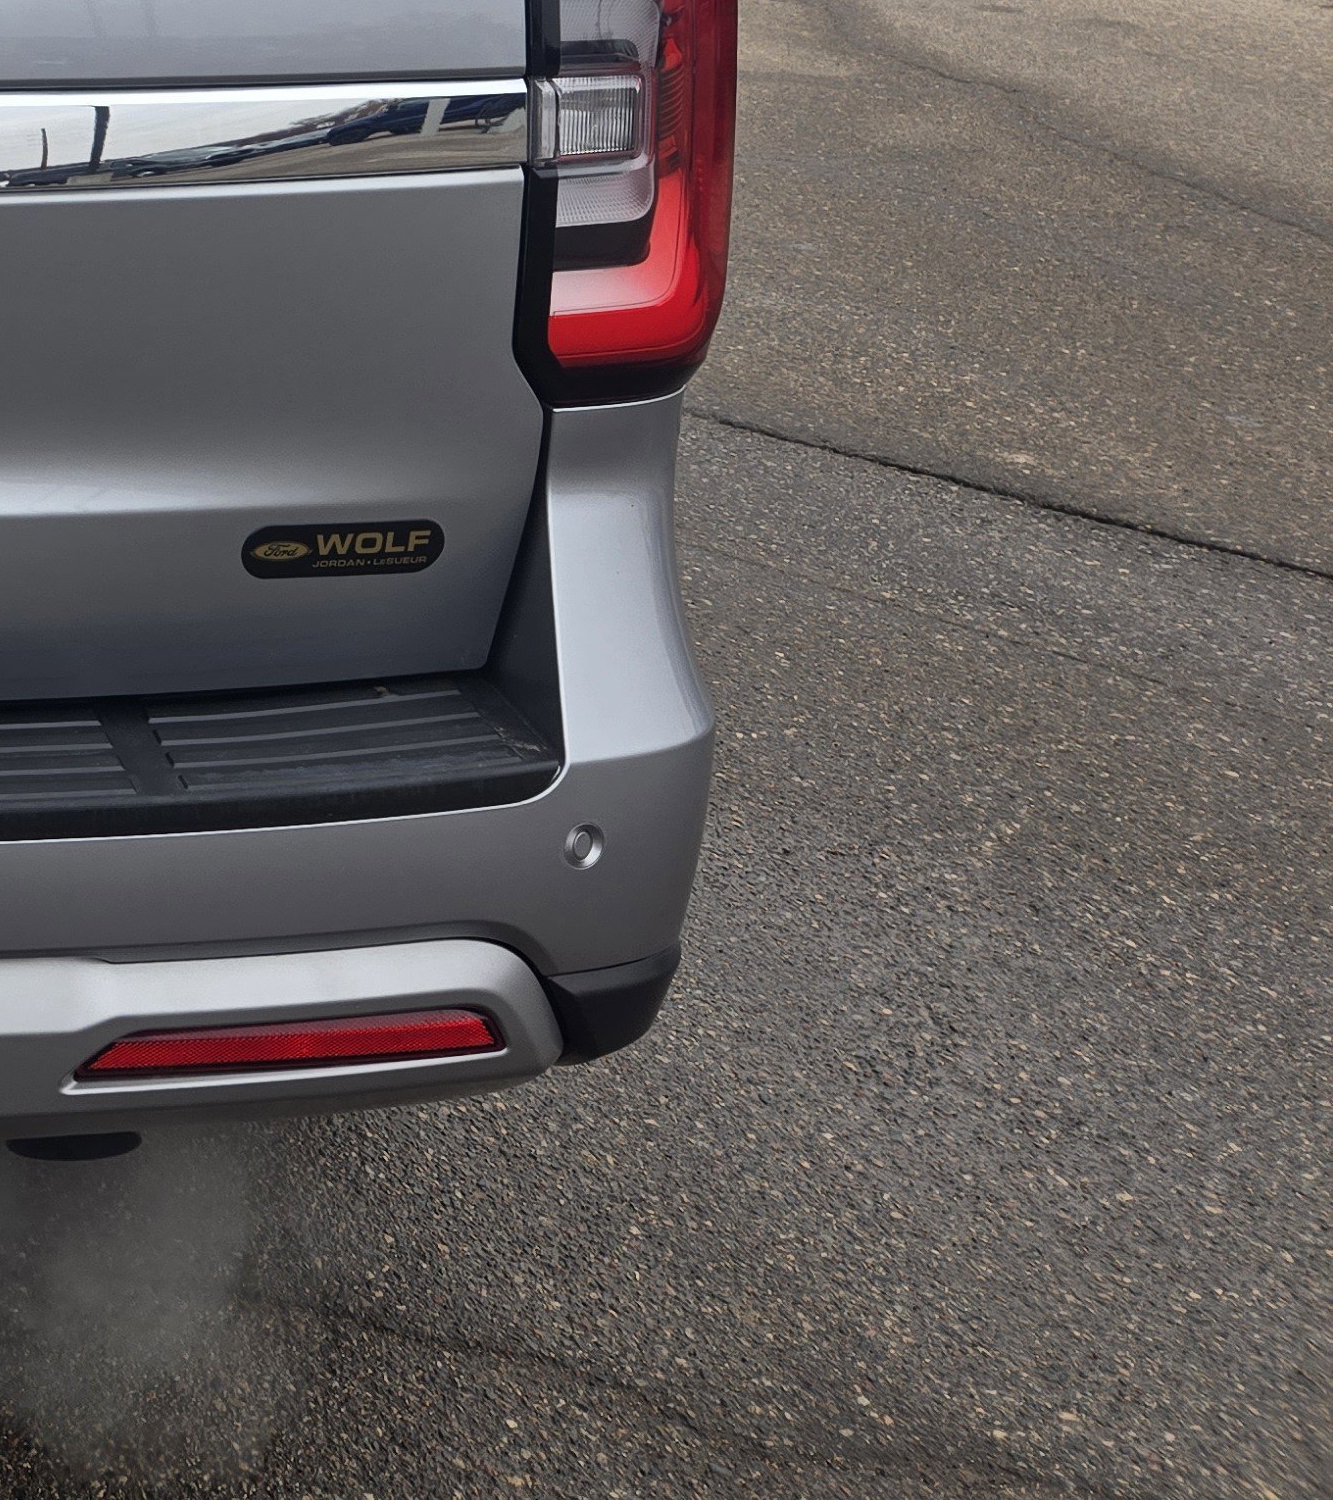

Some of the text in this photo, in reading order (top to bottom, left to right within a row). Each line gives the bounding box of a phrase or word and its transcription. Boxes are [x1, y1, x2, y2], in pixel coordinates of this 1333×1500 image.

[263, 543, 299, 557] Ford
[316, 530, 431, 556] WOLF
[312, 558, 365, 568] JORDAN
